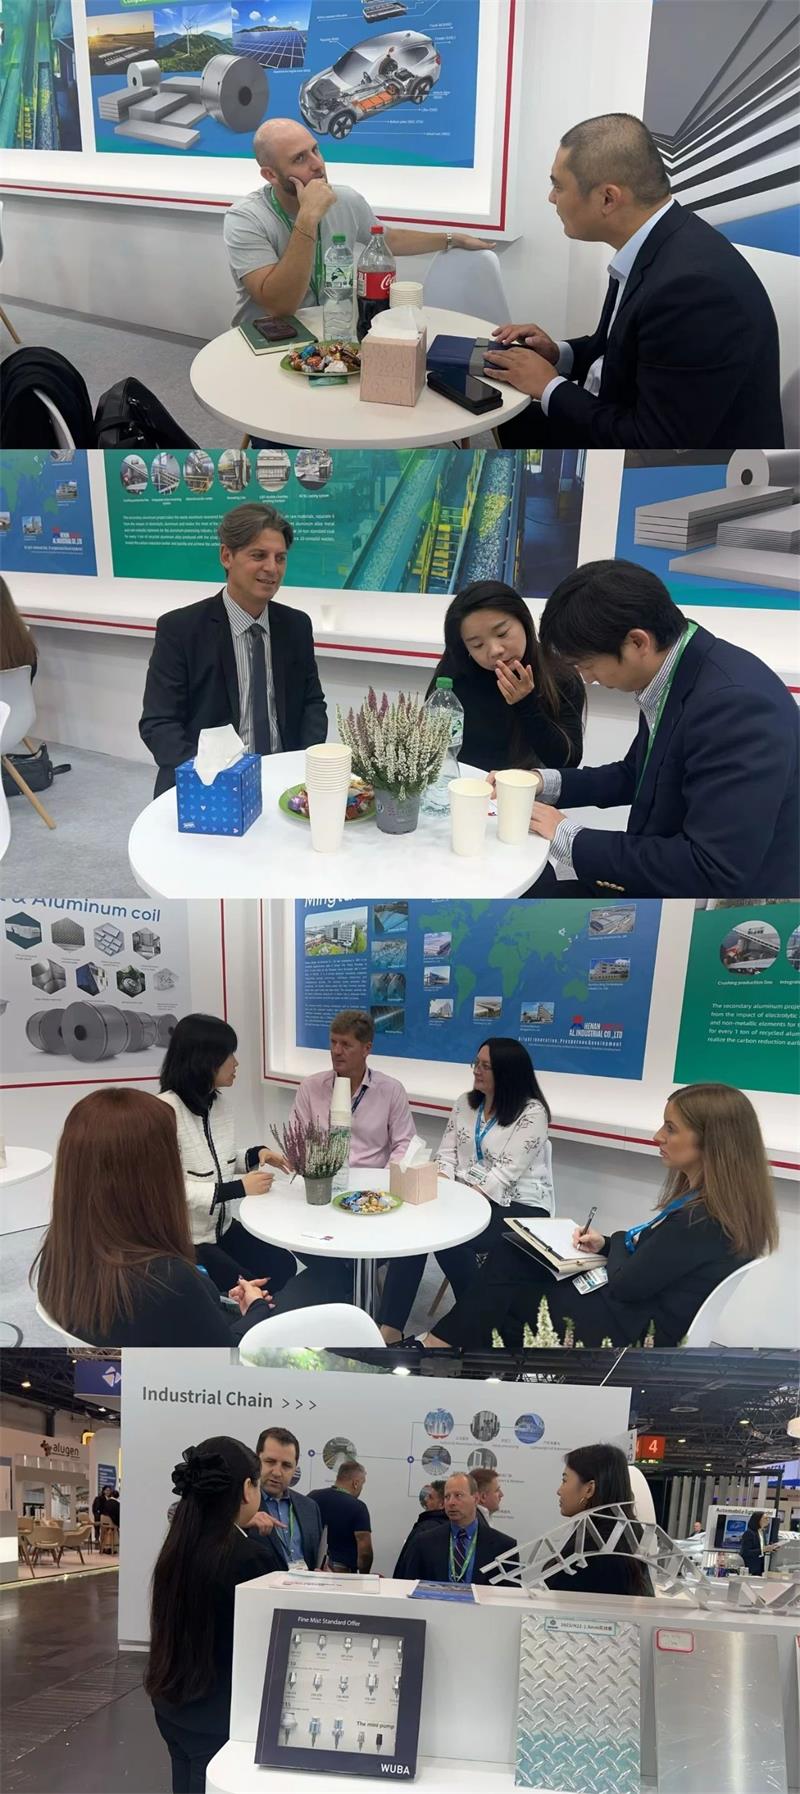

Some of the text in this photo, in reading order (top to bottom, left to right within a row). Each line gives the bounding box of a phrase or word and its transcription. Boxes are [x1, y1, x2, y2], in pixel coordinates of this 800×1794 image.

[32, 898, 126, 917] Aluminum
[131, 909, 161, 922] coil
[142, 1386, 272, 1408] Industrial Chain
[53, 1442, 79, 1456] alugen
[648, 1440, 658, 1453] 4
[380, 1763, 410, 1775] WUBA
